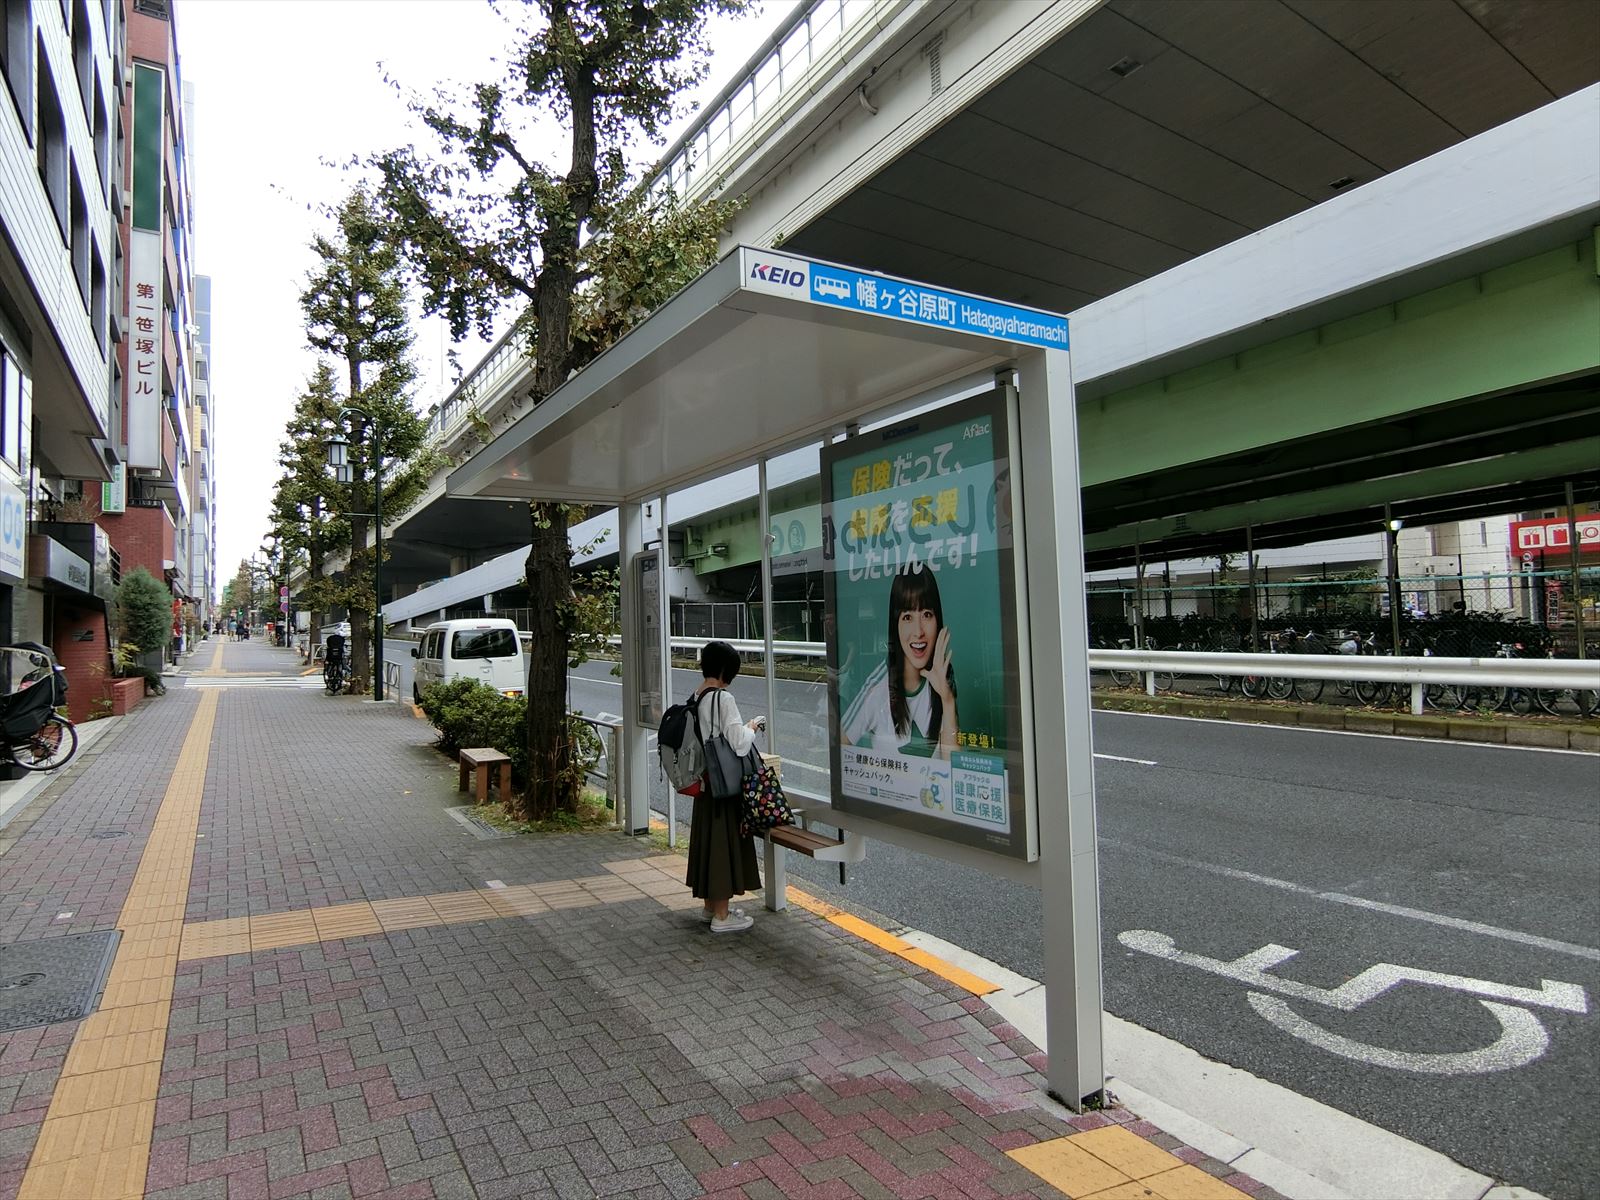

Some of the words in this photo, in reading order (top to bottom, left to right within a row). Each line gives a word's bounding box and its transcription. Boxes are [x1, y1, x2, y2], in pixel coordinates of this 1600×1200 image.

[751, 263, 805, 287] KEIO
[856, 277, 957, 325] 幡ヶ谷原町
[961, 305, 1067, 343] Hatagayaharamachi
[135, 282, 155, 395] 第一笹塚ビル
[856, 753, 909, 773] 健康なら保険料を
[954, 780, 1002, 803] 健康応援
[955, 797, 1003, 821] 医療保険
